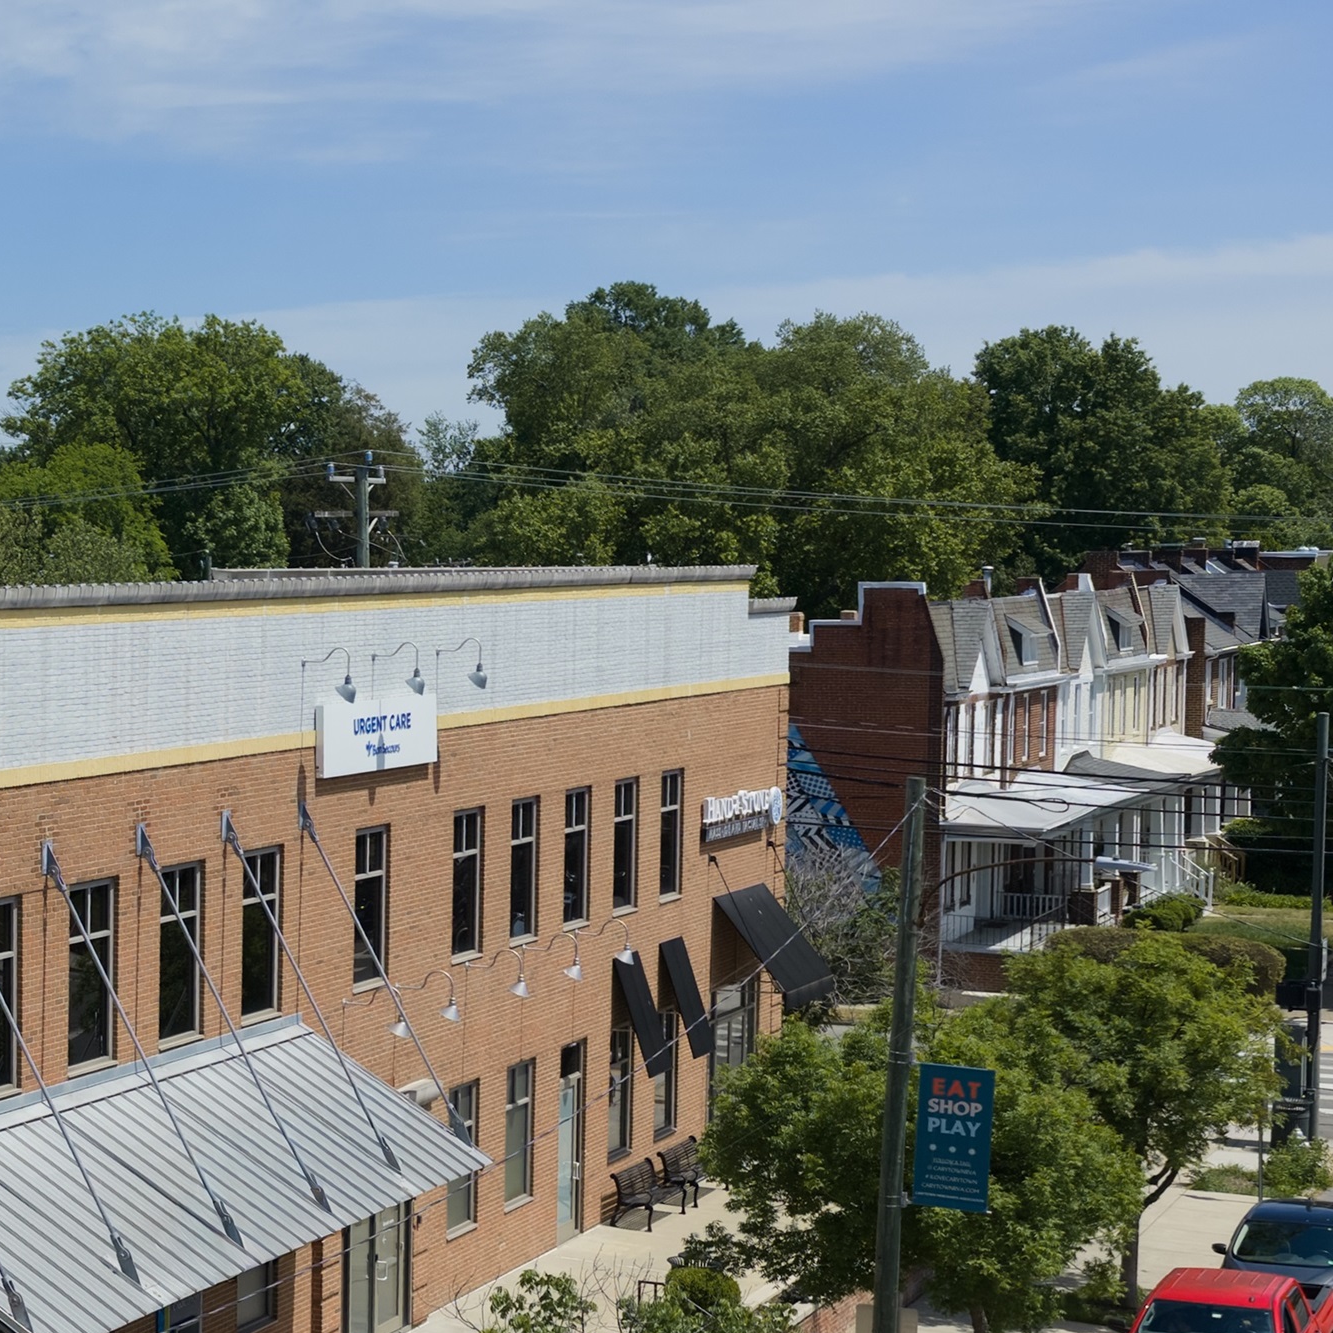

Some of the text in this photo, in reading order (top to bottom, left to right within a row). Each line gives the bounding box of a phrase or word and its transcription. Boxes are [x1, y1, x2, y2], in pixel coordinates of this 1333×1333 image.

[353, 712, 411, 736] URGENT CARE
[932, 1077, 982, 1099] EAT
[927, 1098, 982, 1117] SHOP
[927, 1116, 981, 1138] PLAY
